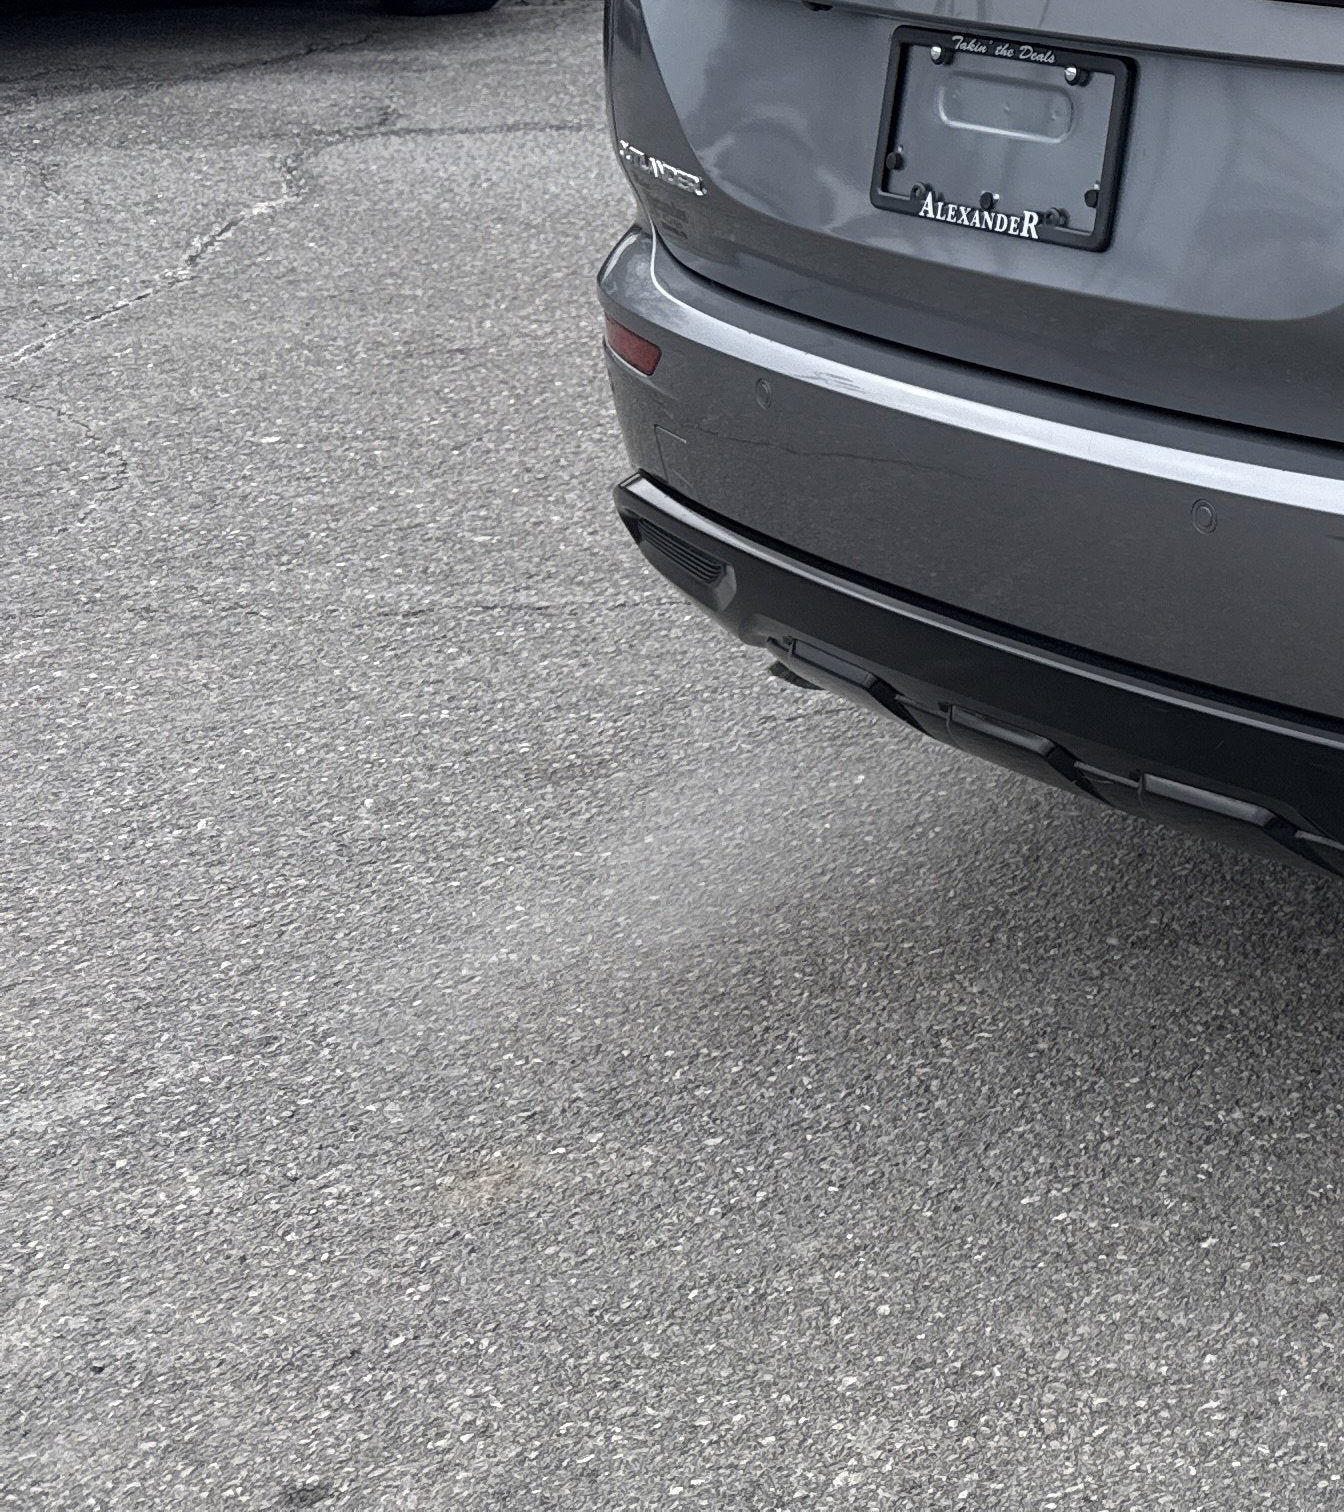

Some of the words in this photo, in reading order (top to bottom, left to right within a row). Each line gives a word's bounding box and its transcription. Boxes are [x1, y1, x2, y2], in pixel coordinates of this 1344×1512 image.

[995, 43, 1015, 57] the
[1019, 45, 1056, 64] Deals
[918, 191, 1039, 239] ALEXANDER
